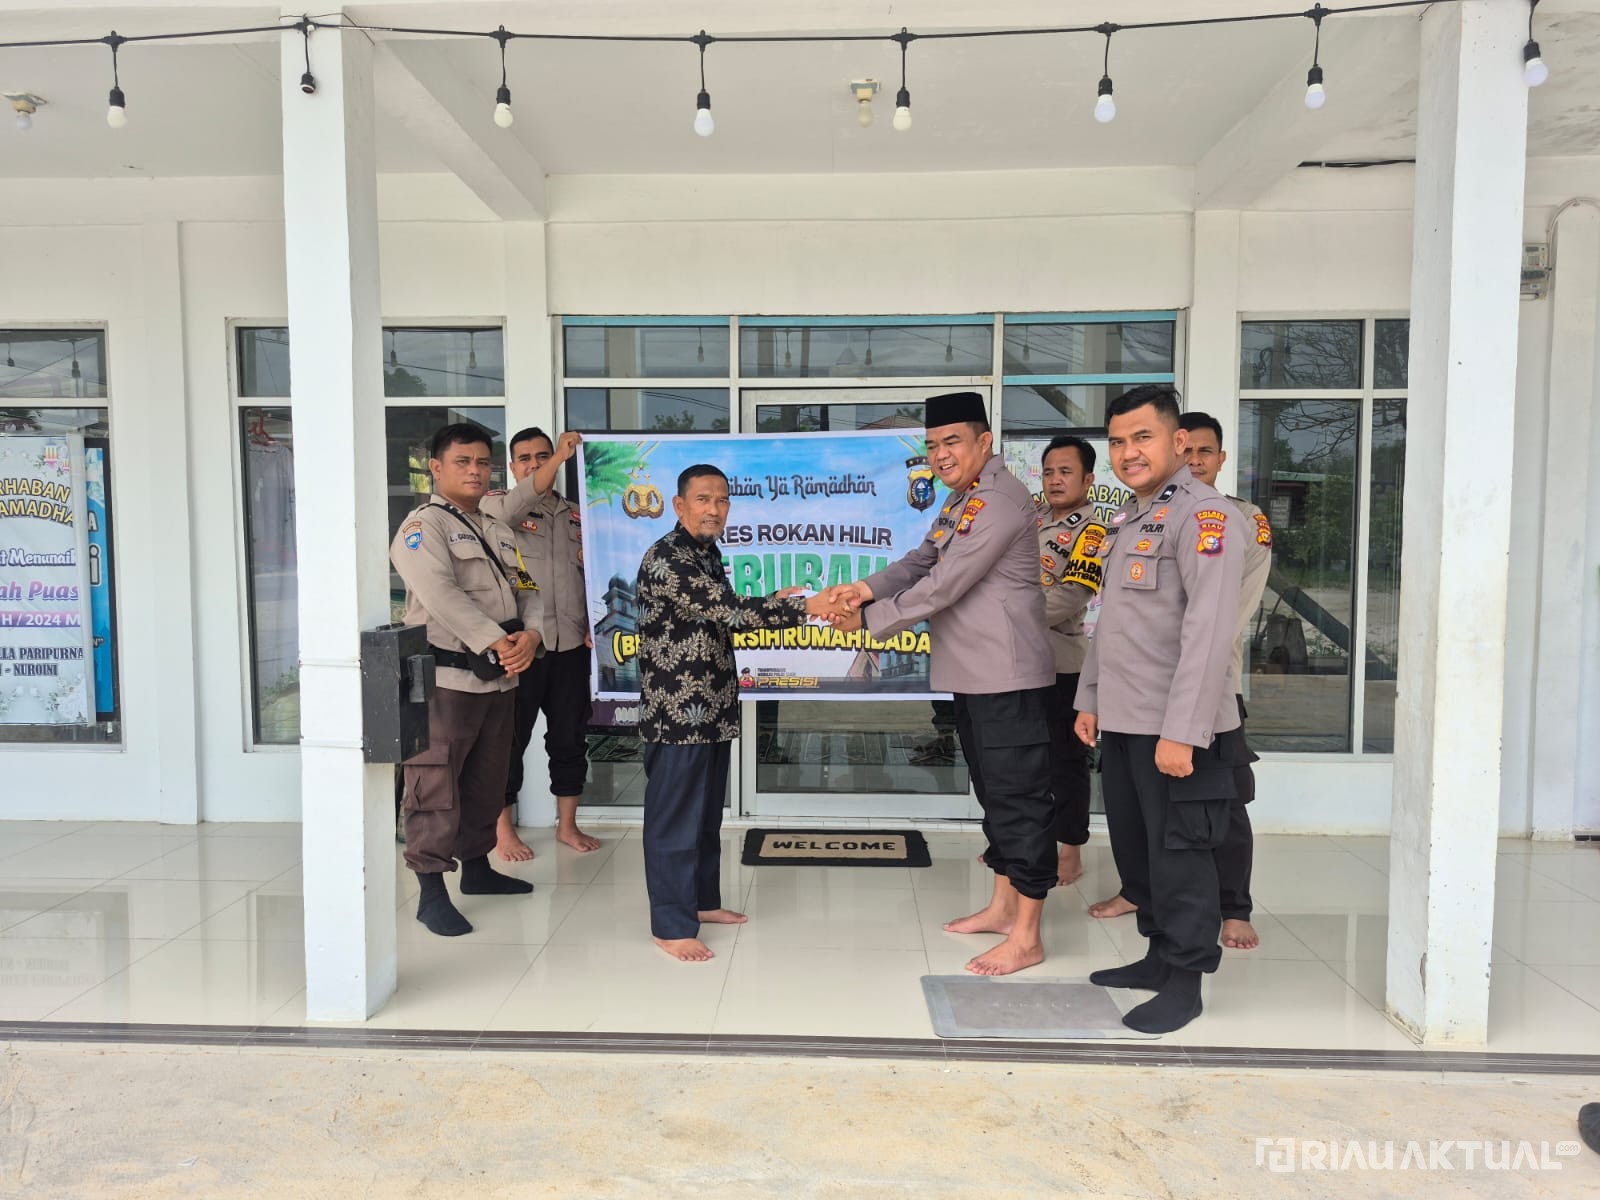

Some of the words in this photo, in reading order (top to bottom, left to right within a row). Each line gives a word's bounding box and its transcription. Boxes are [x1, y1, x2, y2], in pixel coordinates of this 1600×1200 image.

[1139, 523, 1165, 533] POLRI
[757, 523, 834, 545] ROKAN
[839, 525, 893, 549] HILIR
[25, 613, 62, 626] 2024
[65, 613, 80, 626] M
[783, 626, 861, 650] RUMAH
[757, 676, 820, 688] PRESISI
[772, 840, 896, 851] WELCOME
